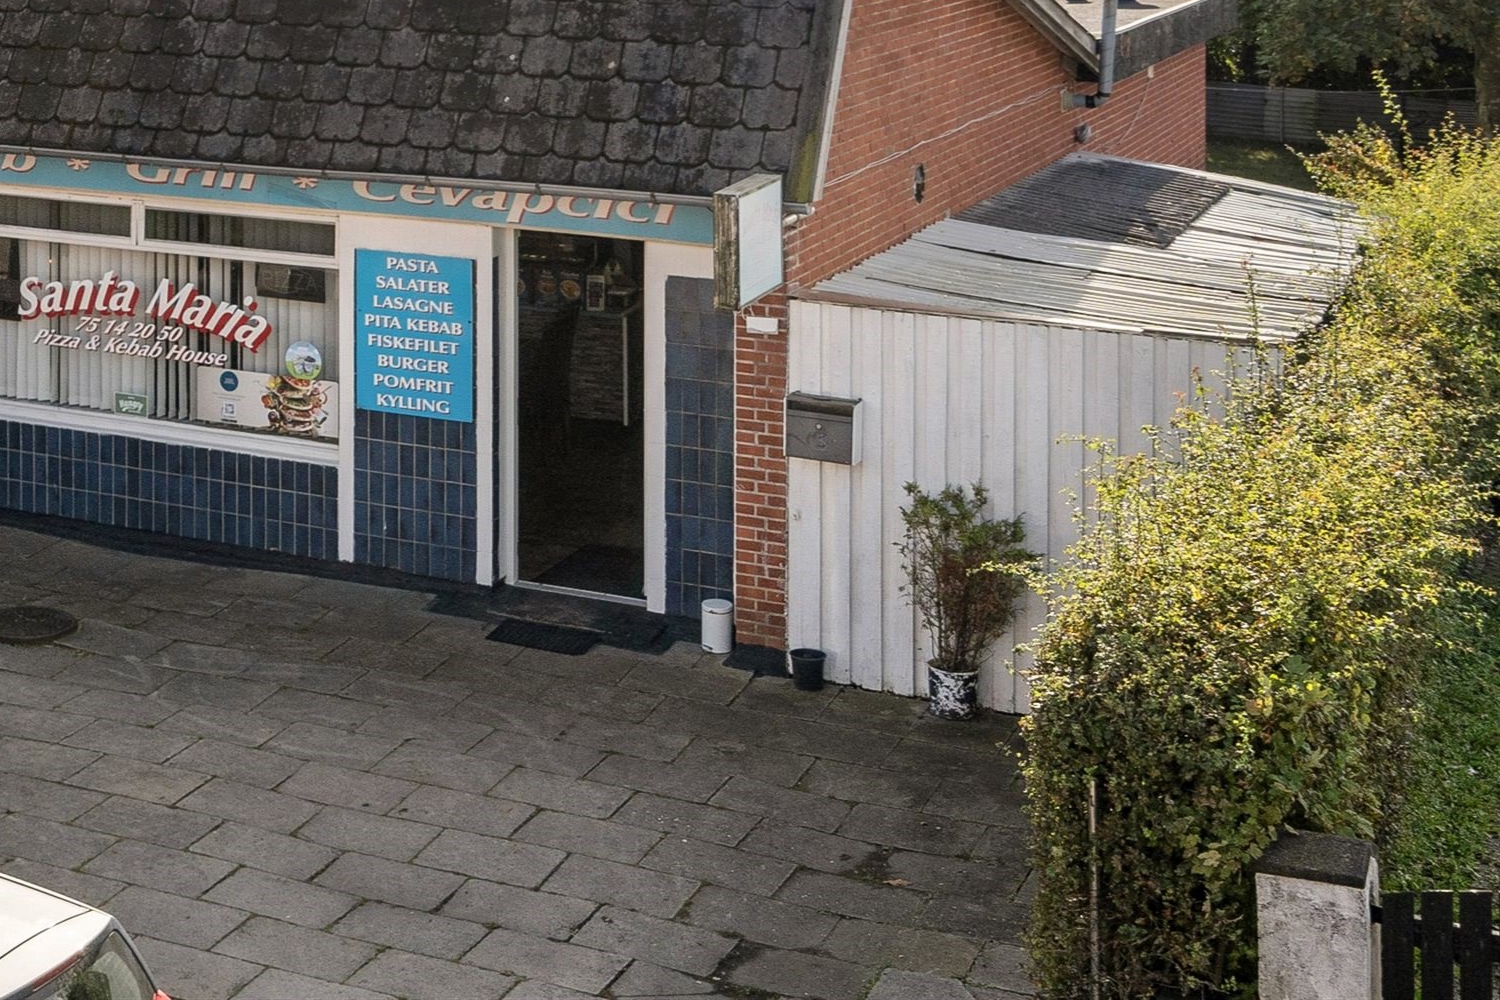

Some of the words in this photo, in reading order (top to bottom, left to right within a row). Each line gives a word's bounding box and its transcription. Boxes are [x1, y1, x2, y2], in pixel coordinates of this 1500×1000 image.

[386, 256, 439, 274] PASTA
[376, 275, 451, 295] SALATER
[18, 270, 138, 319] Santa
[146, 277, 271, 352] Maria
[372, 294, 454, 315] LASAGNE
[75, 316, 100, 332] 75
[104, 318, 128, 336] 14
[128, 322, 153, 339] 20
[155, 325, 184, 343] 50
[364, 313, 402, 330] PITA
[406, 317, 463, 336] KEBAB
[33, 328, 81, 349] Pizza
[85, 335, 101, 350] &
[104, 336, 164, 359] Kebab
[165, 345, 229, 367] House
[367, 333, 460, 355] FISKEFILET
[377, 354, 450, 374] BURGER
[372, 373, 454, 394] POMFRIT
[376, 393, 451, 414] KYLLING
